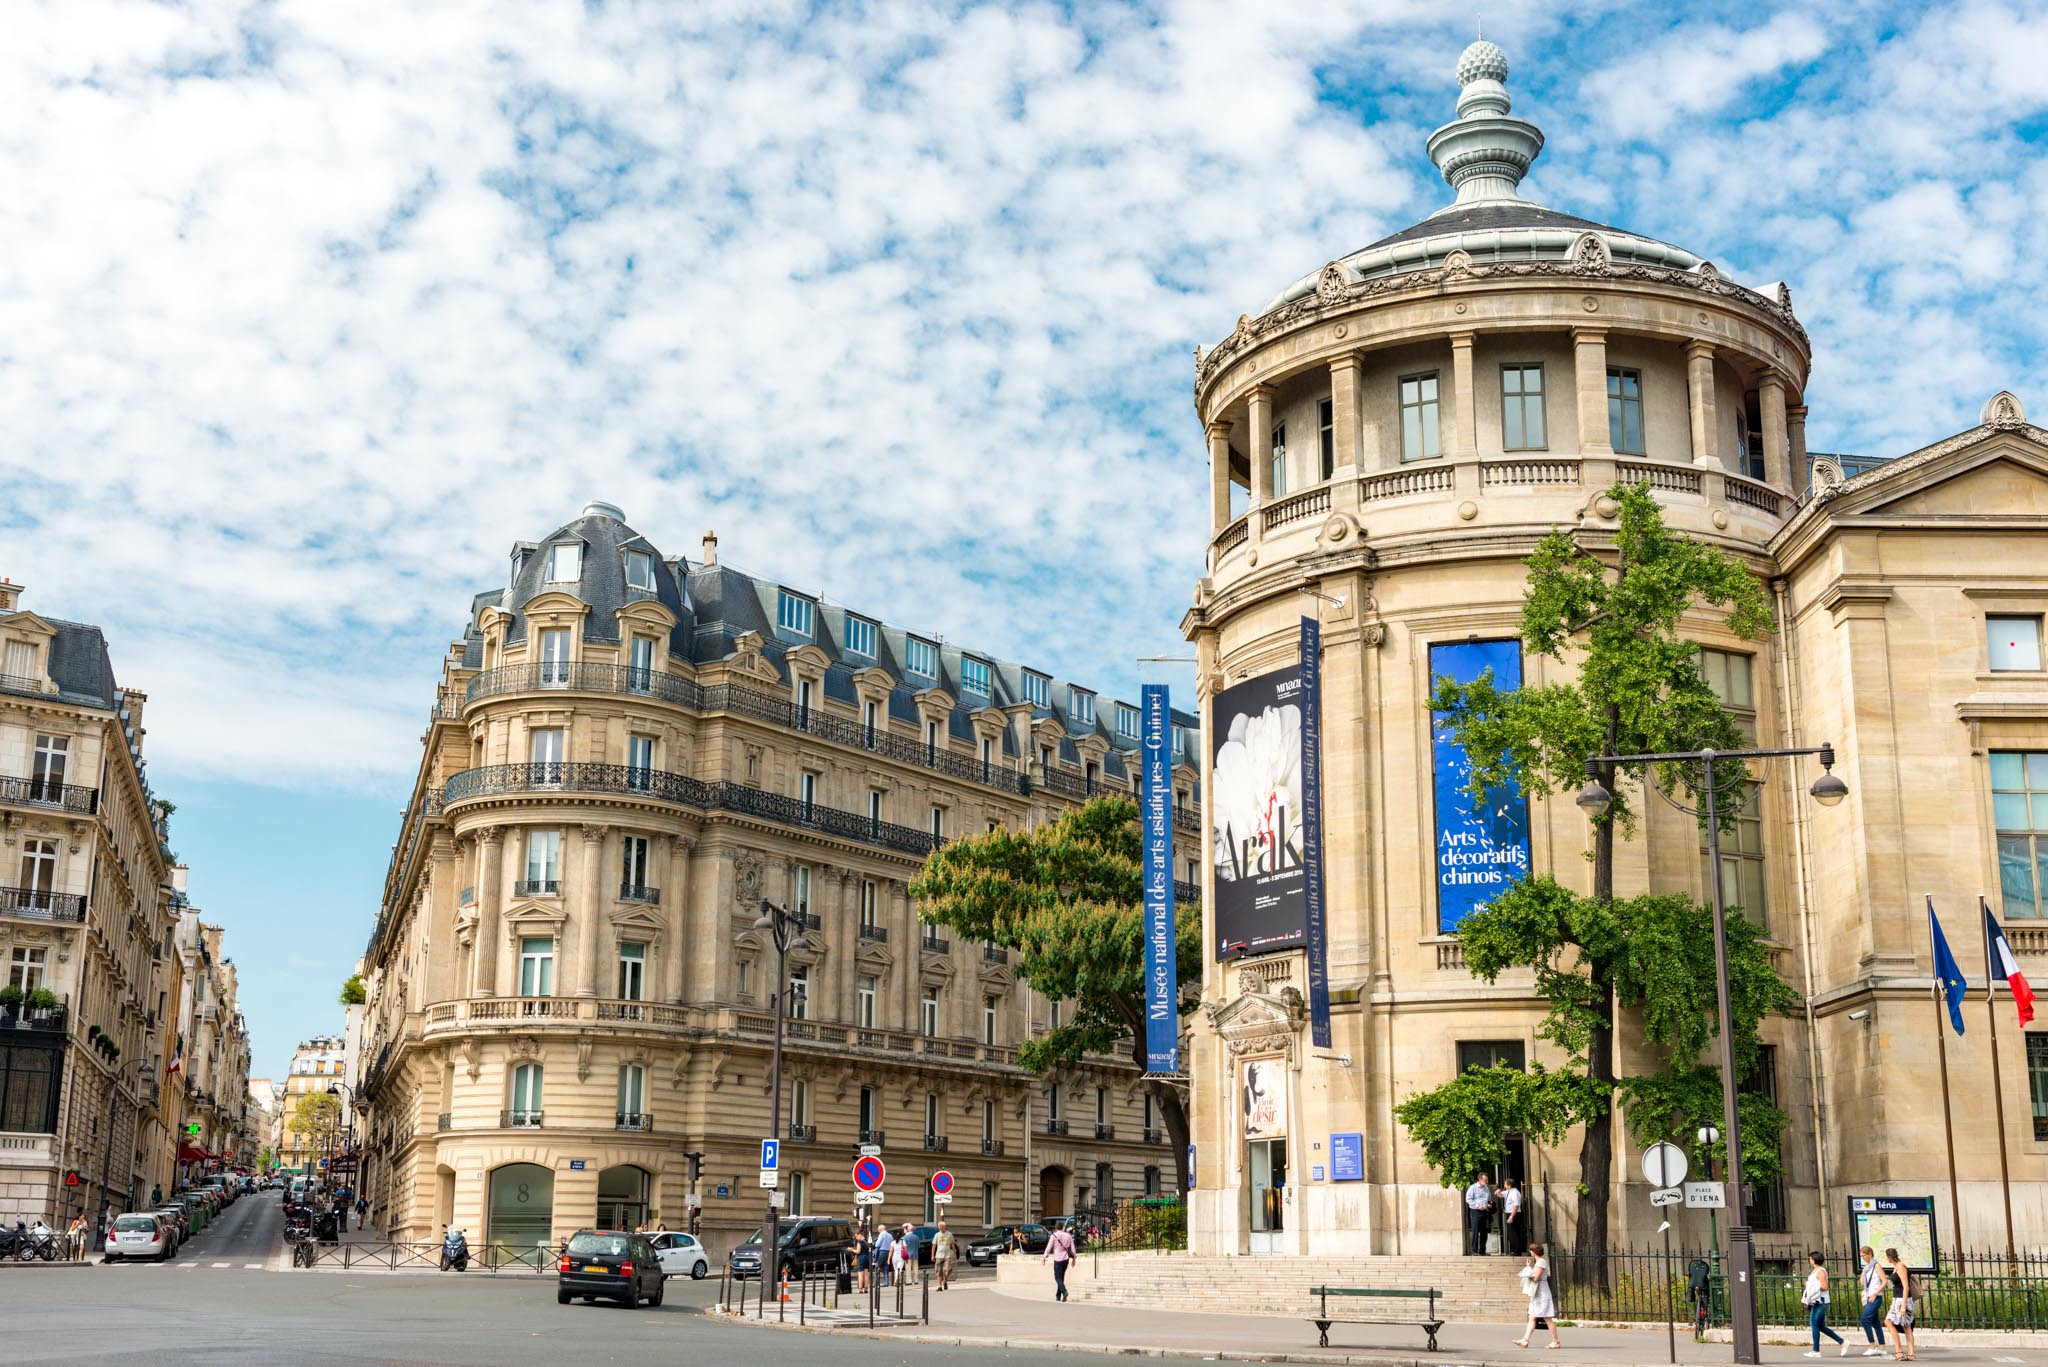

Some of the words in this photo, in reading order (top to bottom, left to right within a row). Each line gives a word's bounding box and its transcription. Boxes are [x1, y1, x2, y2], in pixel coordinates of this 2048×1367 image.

[1305, 789, 1316, 821] arts
[1305, 824, 1317, 856] des
[1439, 828, 1477, 847] Arts
[1150, 839, 1165, 868] arts
[1441, 845, 1527, 866] décoratifs
[1147, 873, 1165, 900] des
[1441, 865, 1502, 886] chinois
[1305, 859, 1322, 927] national
[1148, 903, 1167, 963] national
[1150, 966, 1169, 1020] Musée
[765, 1145, 774, 1165] P
[516, 1183, 530, 1204] 8
[1878, 1201, 1897, 1209] Iéna
